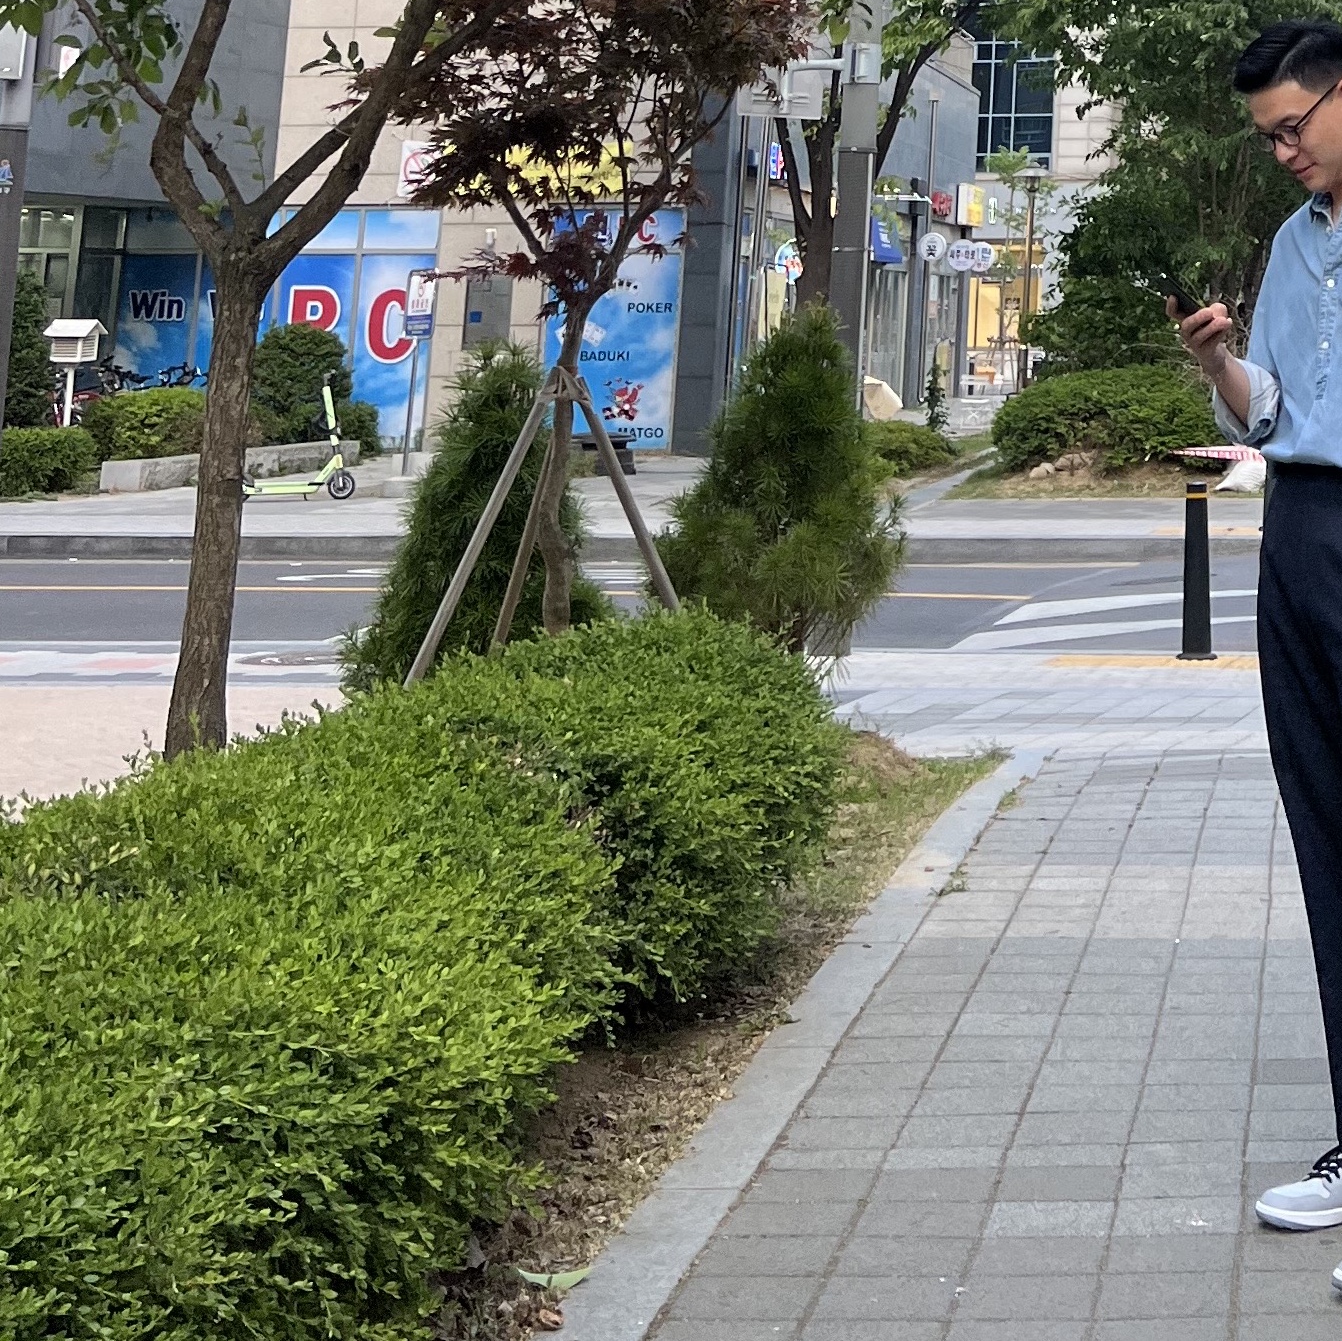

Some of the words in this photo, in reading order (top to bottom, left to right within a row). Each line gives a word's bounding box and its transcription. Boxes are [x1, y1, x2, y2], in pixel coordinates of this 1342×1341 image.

[129, 289, 186, 322] Win
[626, 302, 673, 314] POKER
[579, 350, 631, 362] BADUKI
